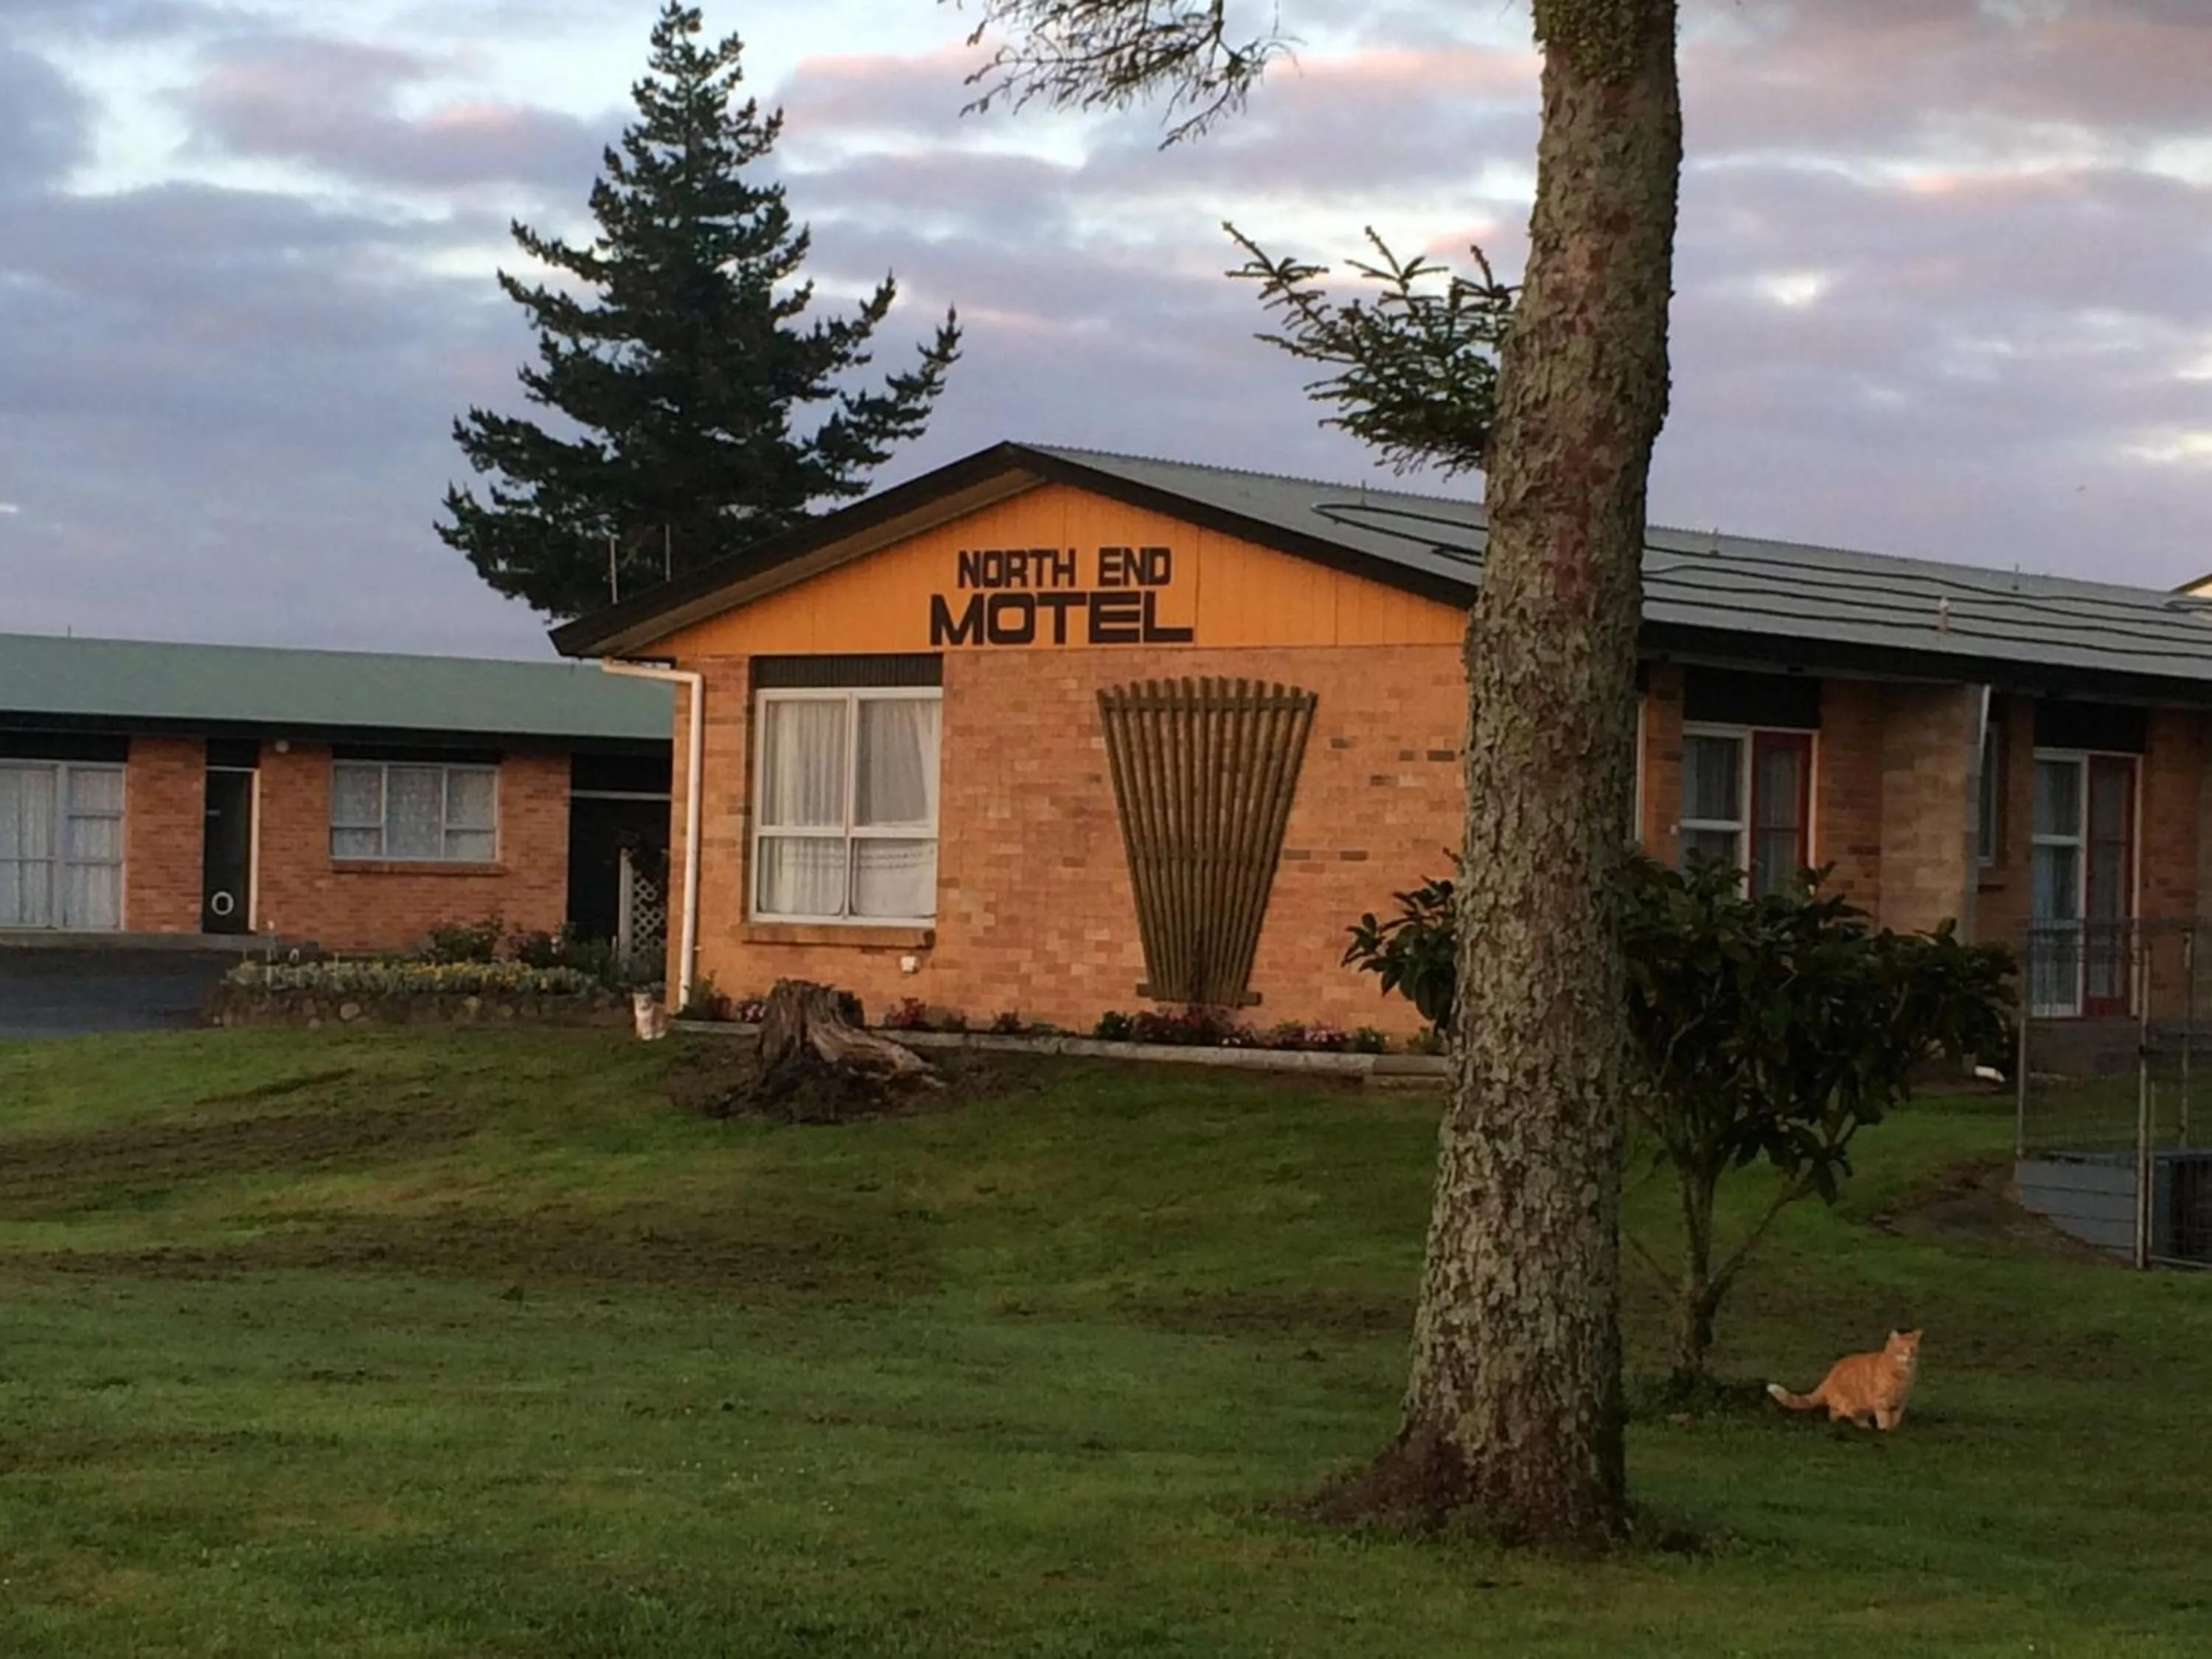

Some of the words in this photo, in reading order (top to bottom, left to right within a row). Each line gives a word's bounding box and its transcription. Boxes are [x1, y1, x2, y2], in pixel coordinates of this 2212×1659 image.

[958, 549, 1076, 588] NORTH
[1099, 547, 1171, 586] END
[931, 591, 1193, 645] MOTEL
